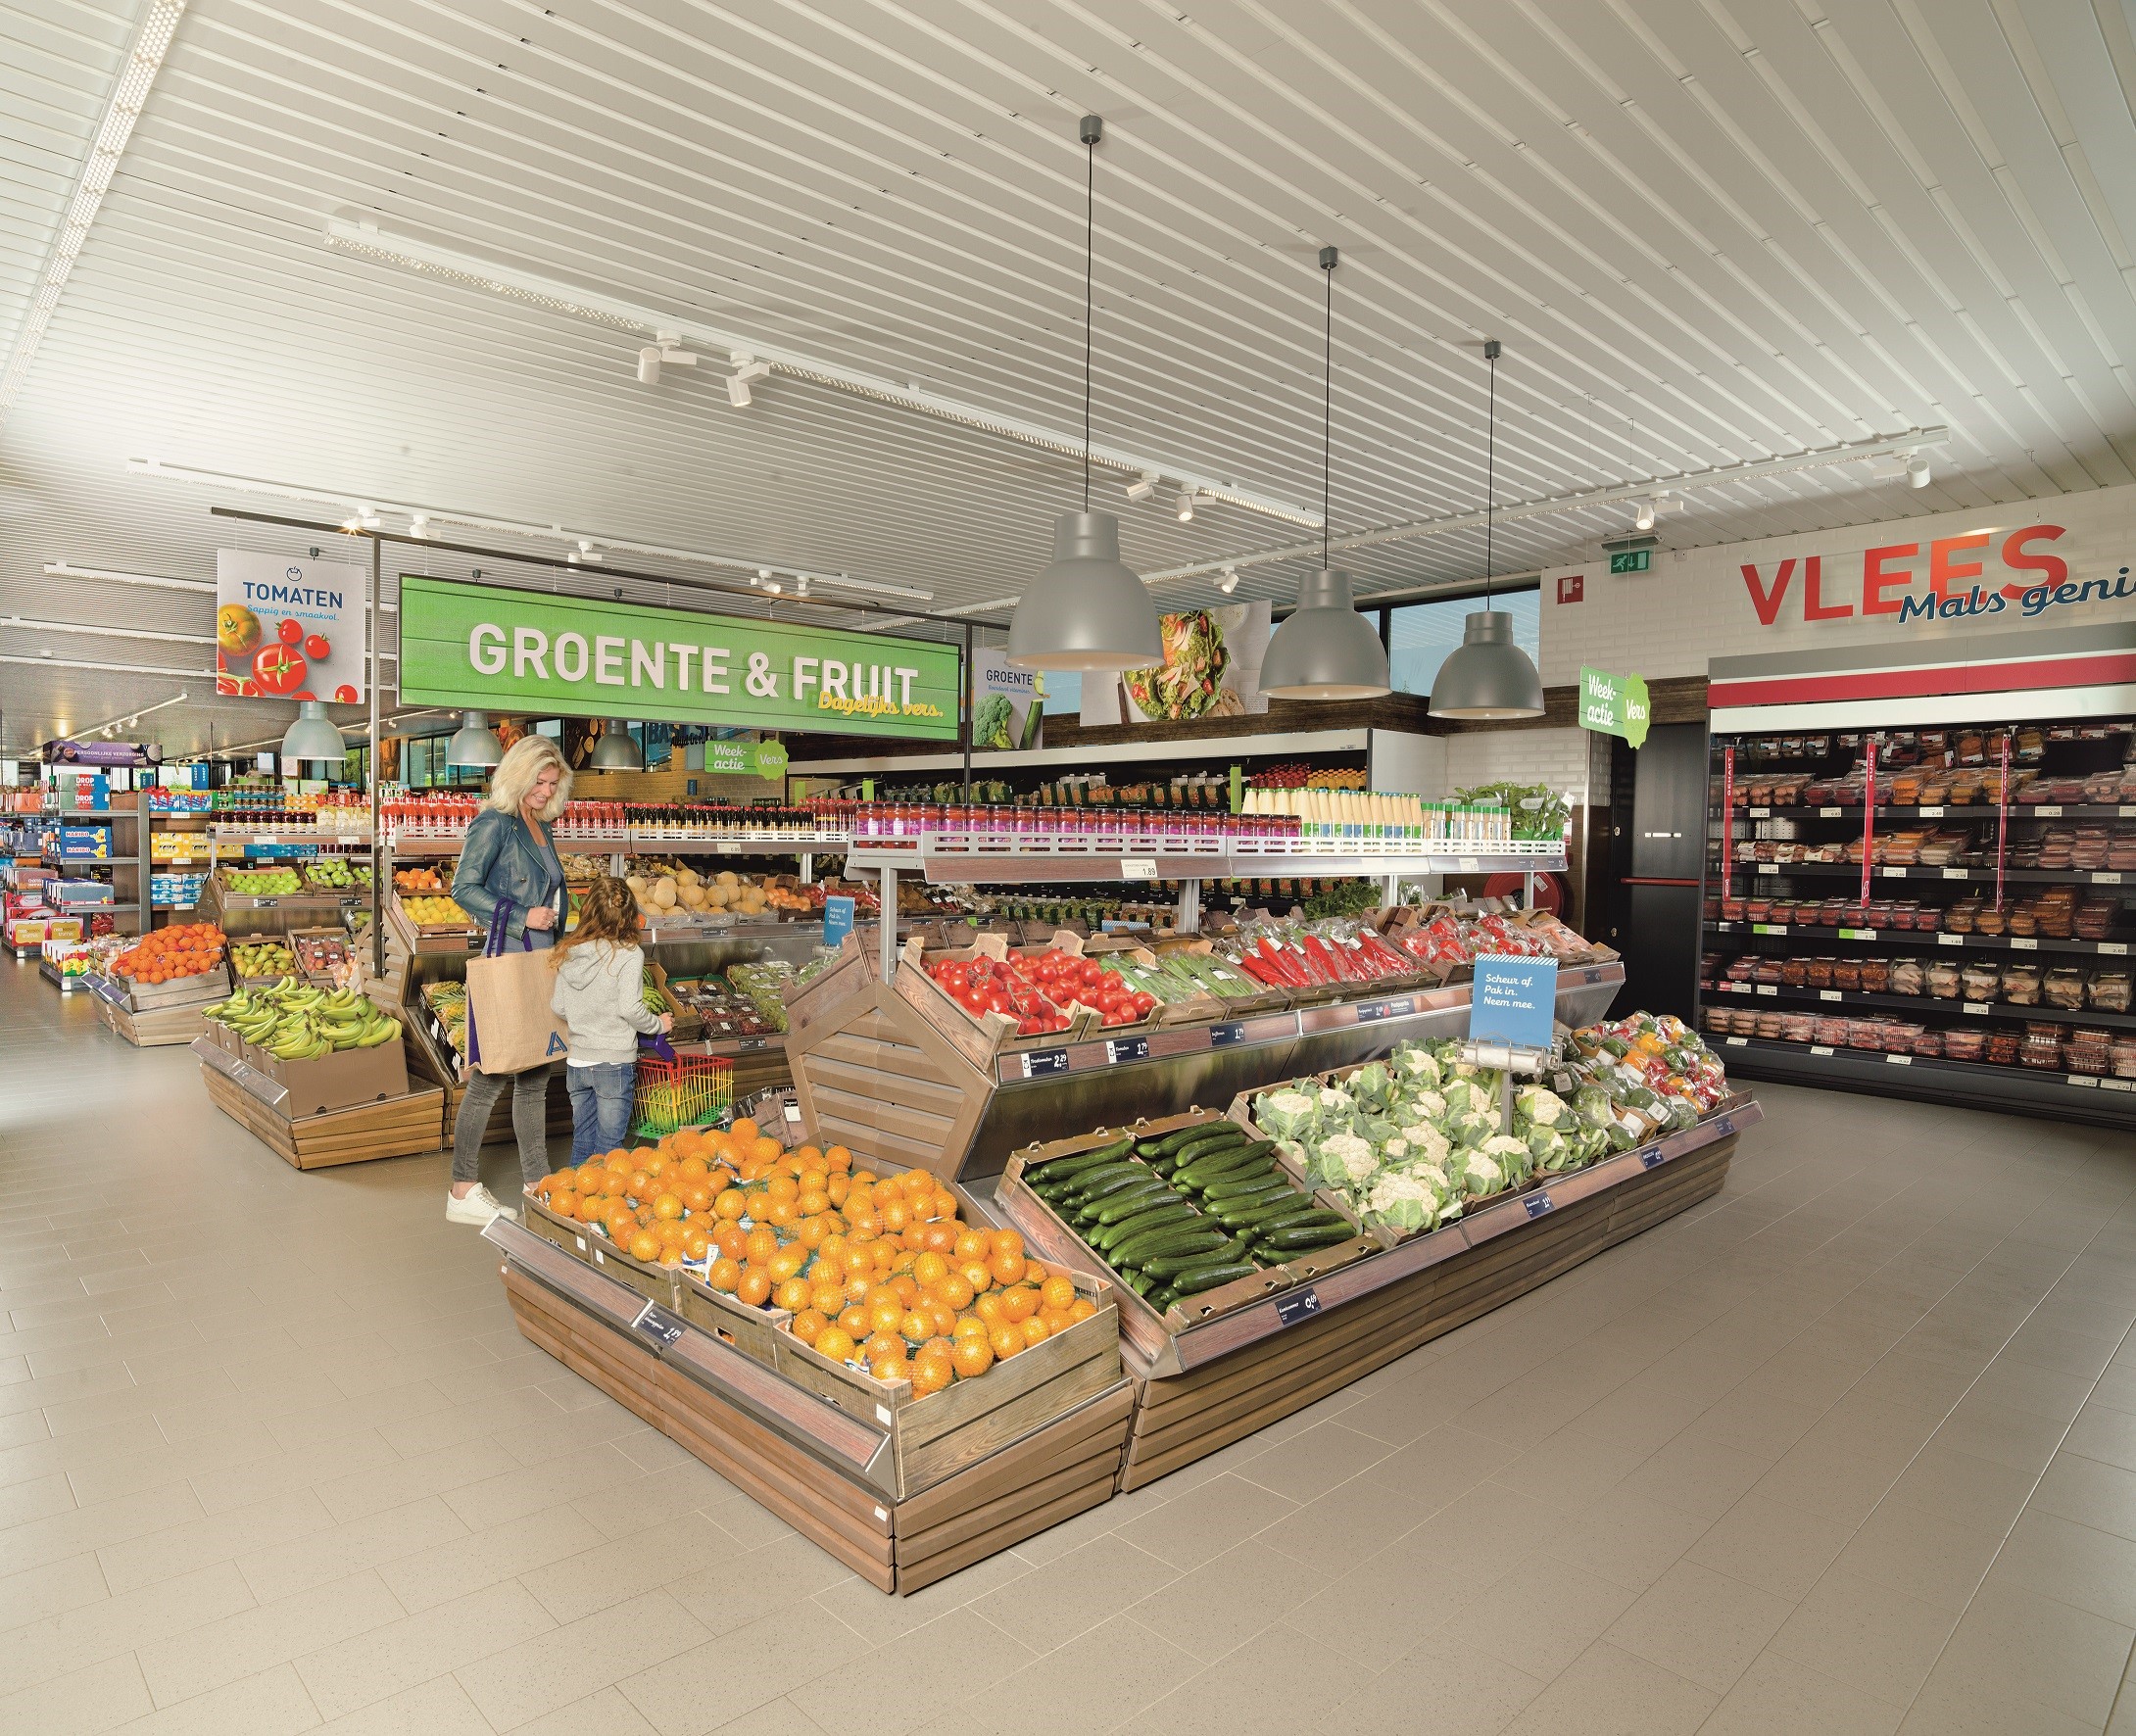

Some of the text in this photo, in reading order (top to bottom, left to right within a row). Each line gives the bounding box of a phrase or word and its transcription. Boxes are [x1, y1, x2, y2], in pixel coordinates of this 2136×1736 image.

[1740, 524, 2068, 626] VLEES
[242, 581, 343, 609] TOMATEN
[1898, 566, 2136, 624] Mals geni
[247, 603, 279, 616] Sappig
[295, 611, 340, 621] smaakvol.
[469, 622, 919, 706] GROENTE & FRUIT
[986, 669, 1034, 686] GROENTE
[1588, 673, 1617, 701] Week-
[818, 691, 944, 718] Dagelijks vers.
[1626, 699, 1646, 720] Vers
[1587, 701, 1615, 727] actie
[713, 744, 748, 757] Week-
[759, 753, 783, 765] Vers
[713, 757, 746, 770] actie
[1141, 867, 1156, 876] 1.89
[1484, 973, 1533, 988] Scheur af.
[1483, 985, 1518, 996] Pak in.
[1483, 996, 1535, 1009] Neem mee.
